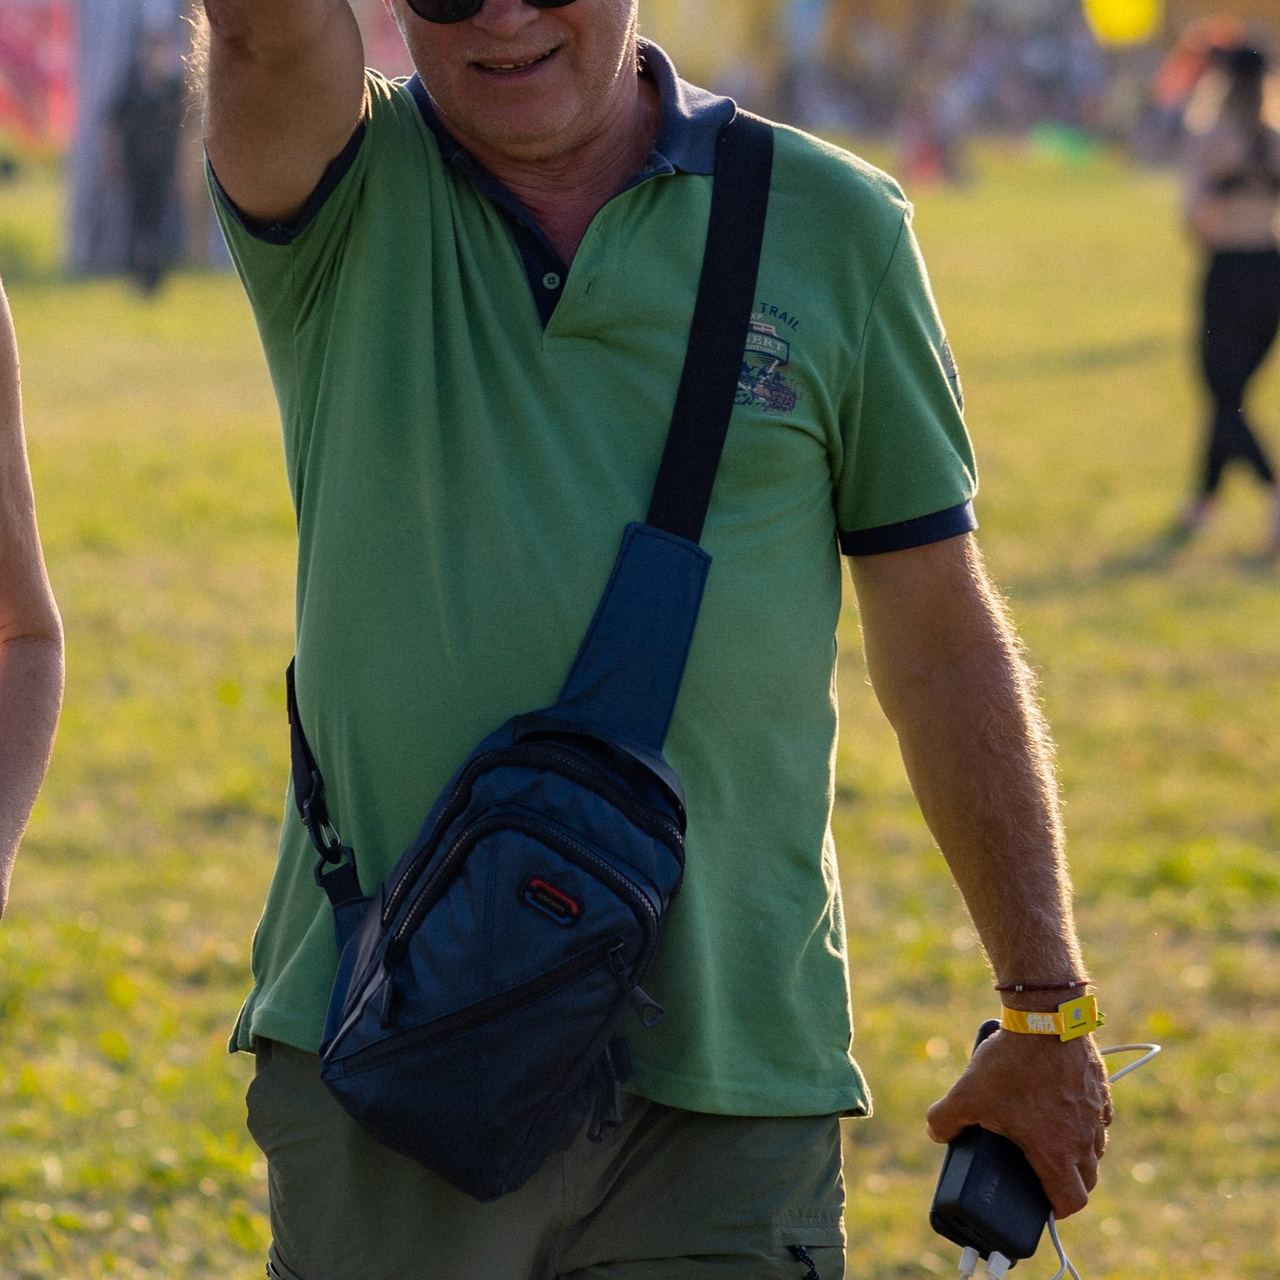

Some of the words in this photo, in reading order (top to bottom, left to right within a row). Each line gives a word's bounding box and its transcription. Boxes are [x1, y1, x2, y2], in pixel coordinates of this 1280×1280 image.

[750, 312, 765, 321] XP.
[760, 302, 799, 331] TRAIL
[746, 333, 785, 350] SERT
